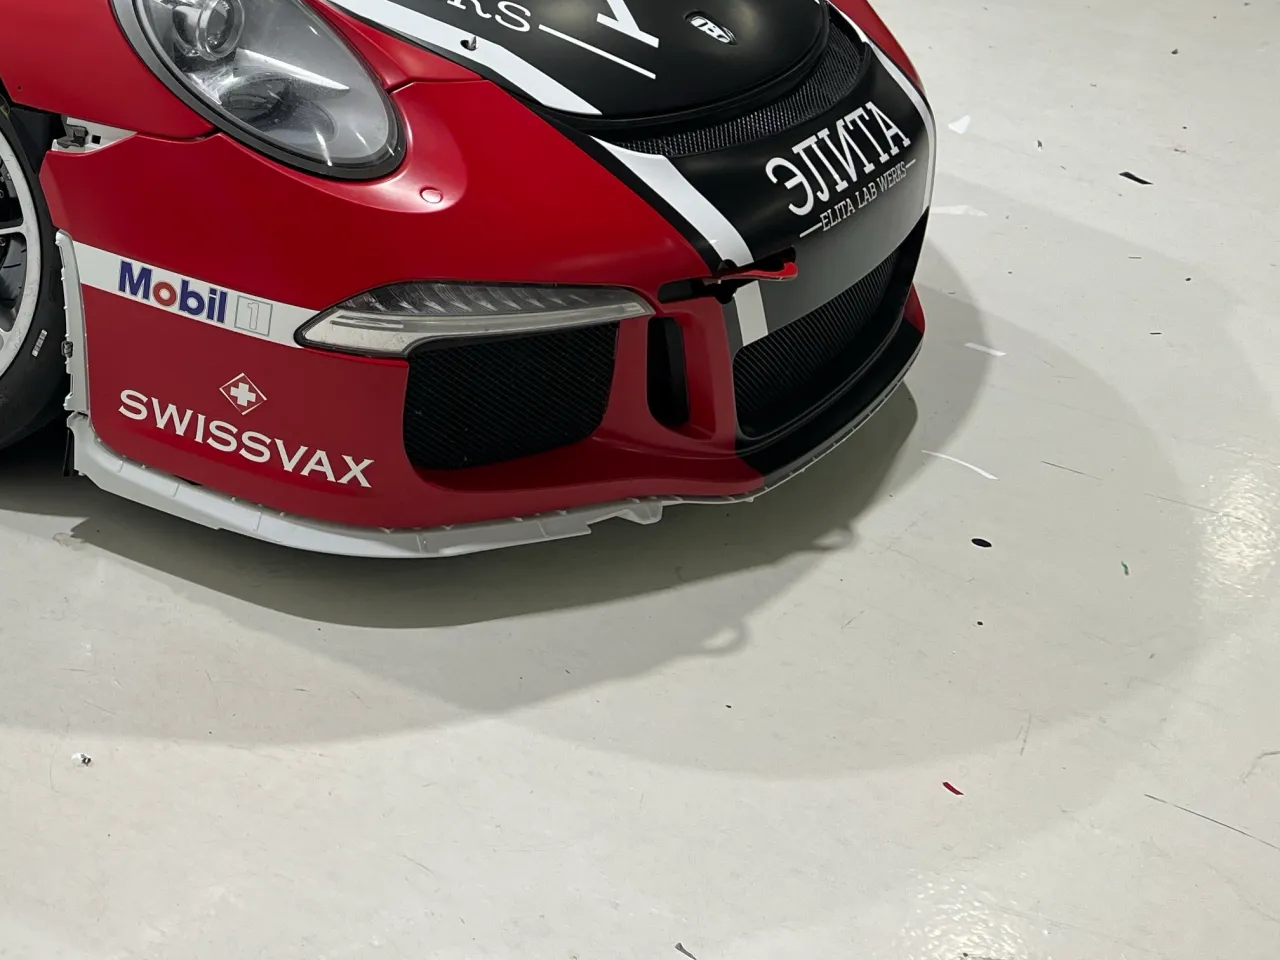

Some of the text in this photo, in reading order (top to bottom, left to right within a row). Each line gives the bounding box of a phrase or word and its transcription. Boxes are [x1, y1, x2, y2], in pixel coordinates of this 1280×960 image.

[820, 161, 907, 232] ELITA LAB WERKS
[117, 260, 228, 324] Mobil
[118, 389, 375, 489] SWISSVAX
